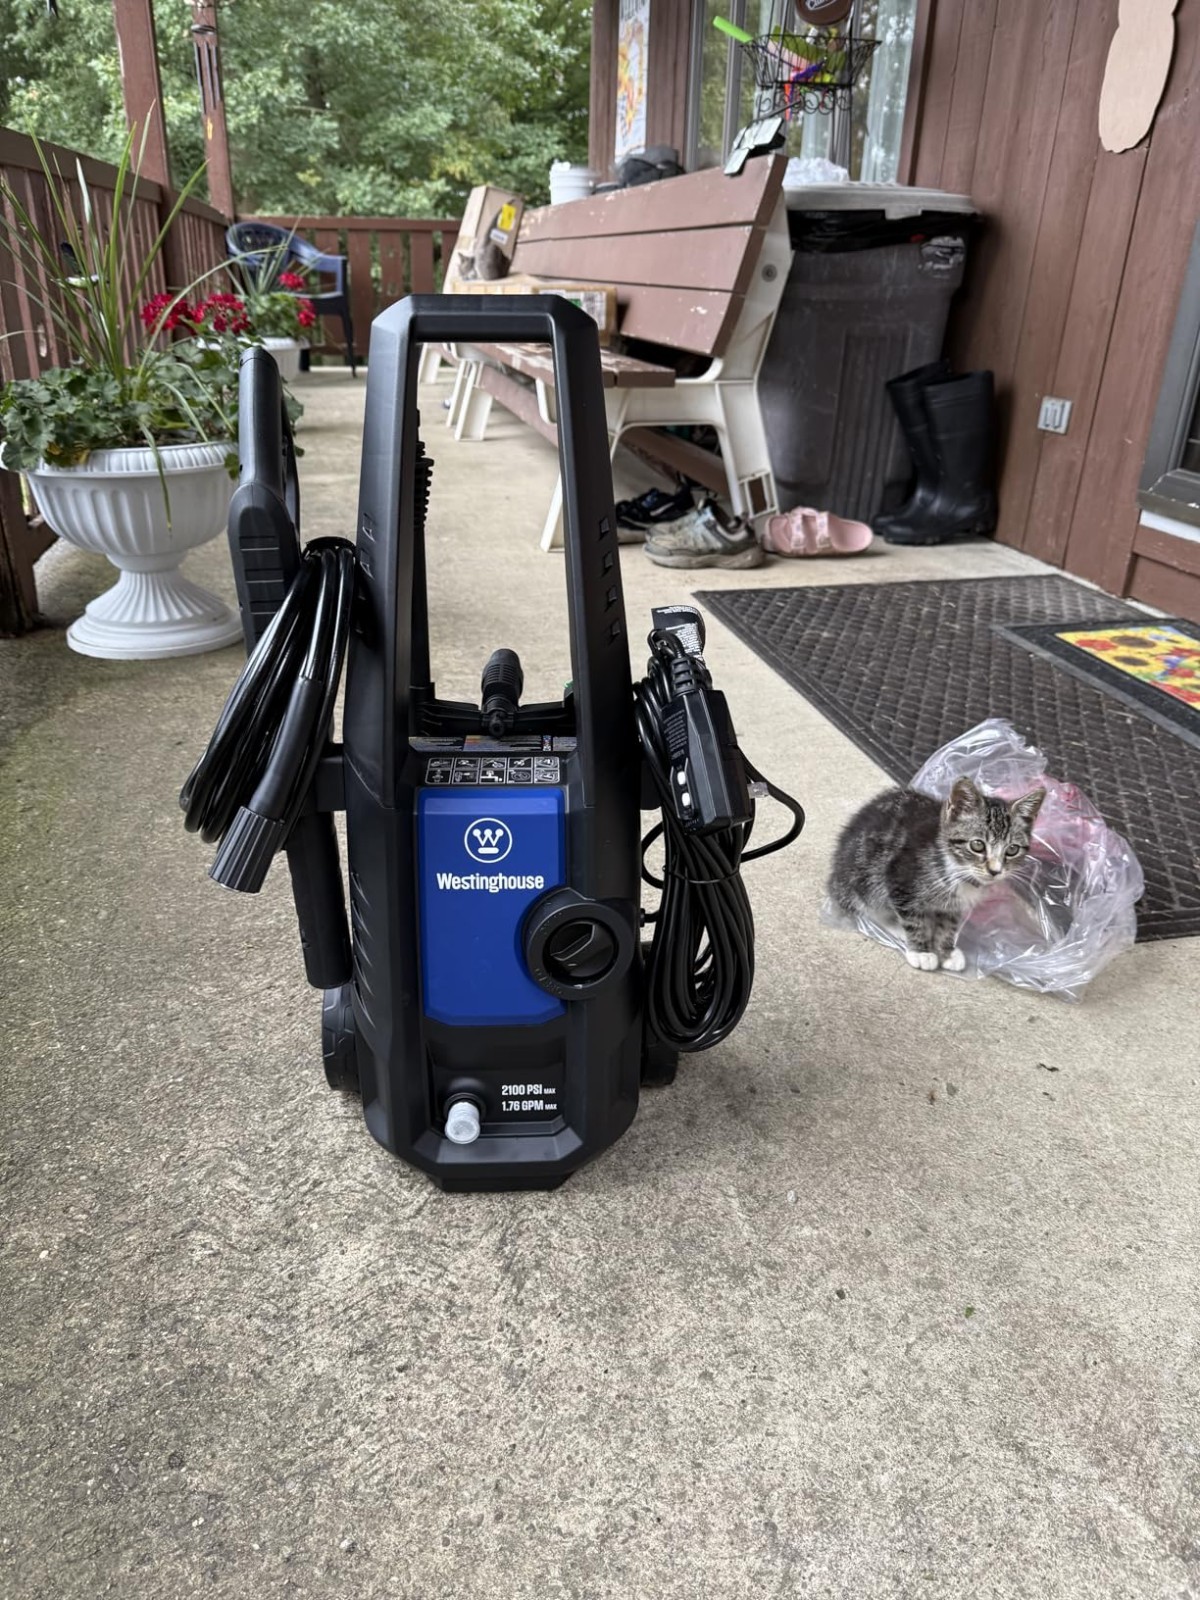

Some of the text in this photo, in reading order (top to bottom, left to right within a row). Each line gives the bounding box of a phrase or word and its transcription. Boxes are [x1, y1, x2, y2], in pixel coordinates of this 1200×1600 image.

[436, 873, 544, 893] Westinghouse
[501, 1084, 526, 1096] 2100
[526, 1084, 542, 1094] PSI
[501, 1100, 520, 1111] 1.76
[521, 1100, 544, 1110] GPM
